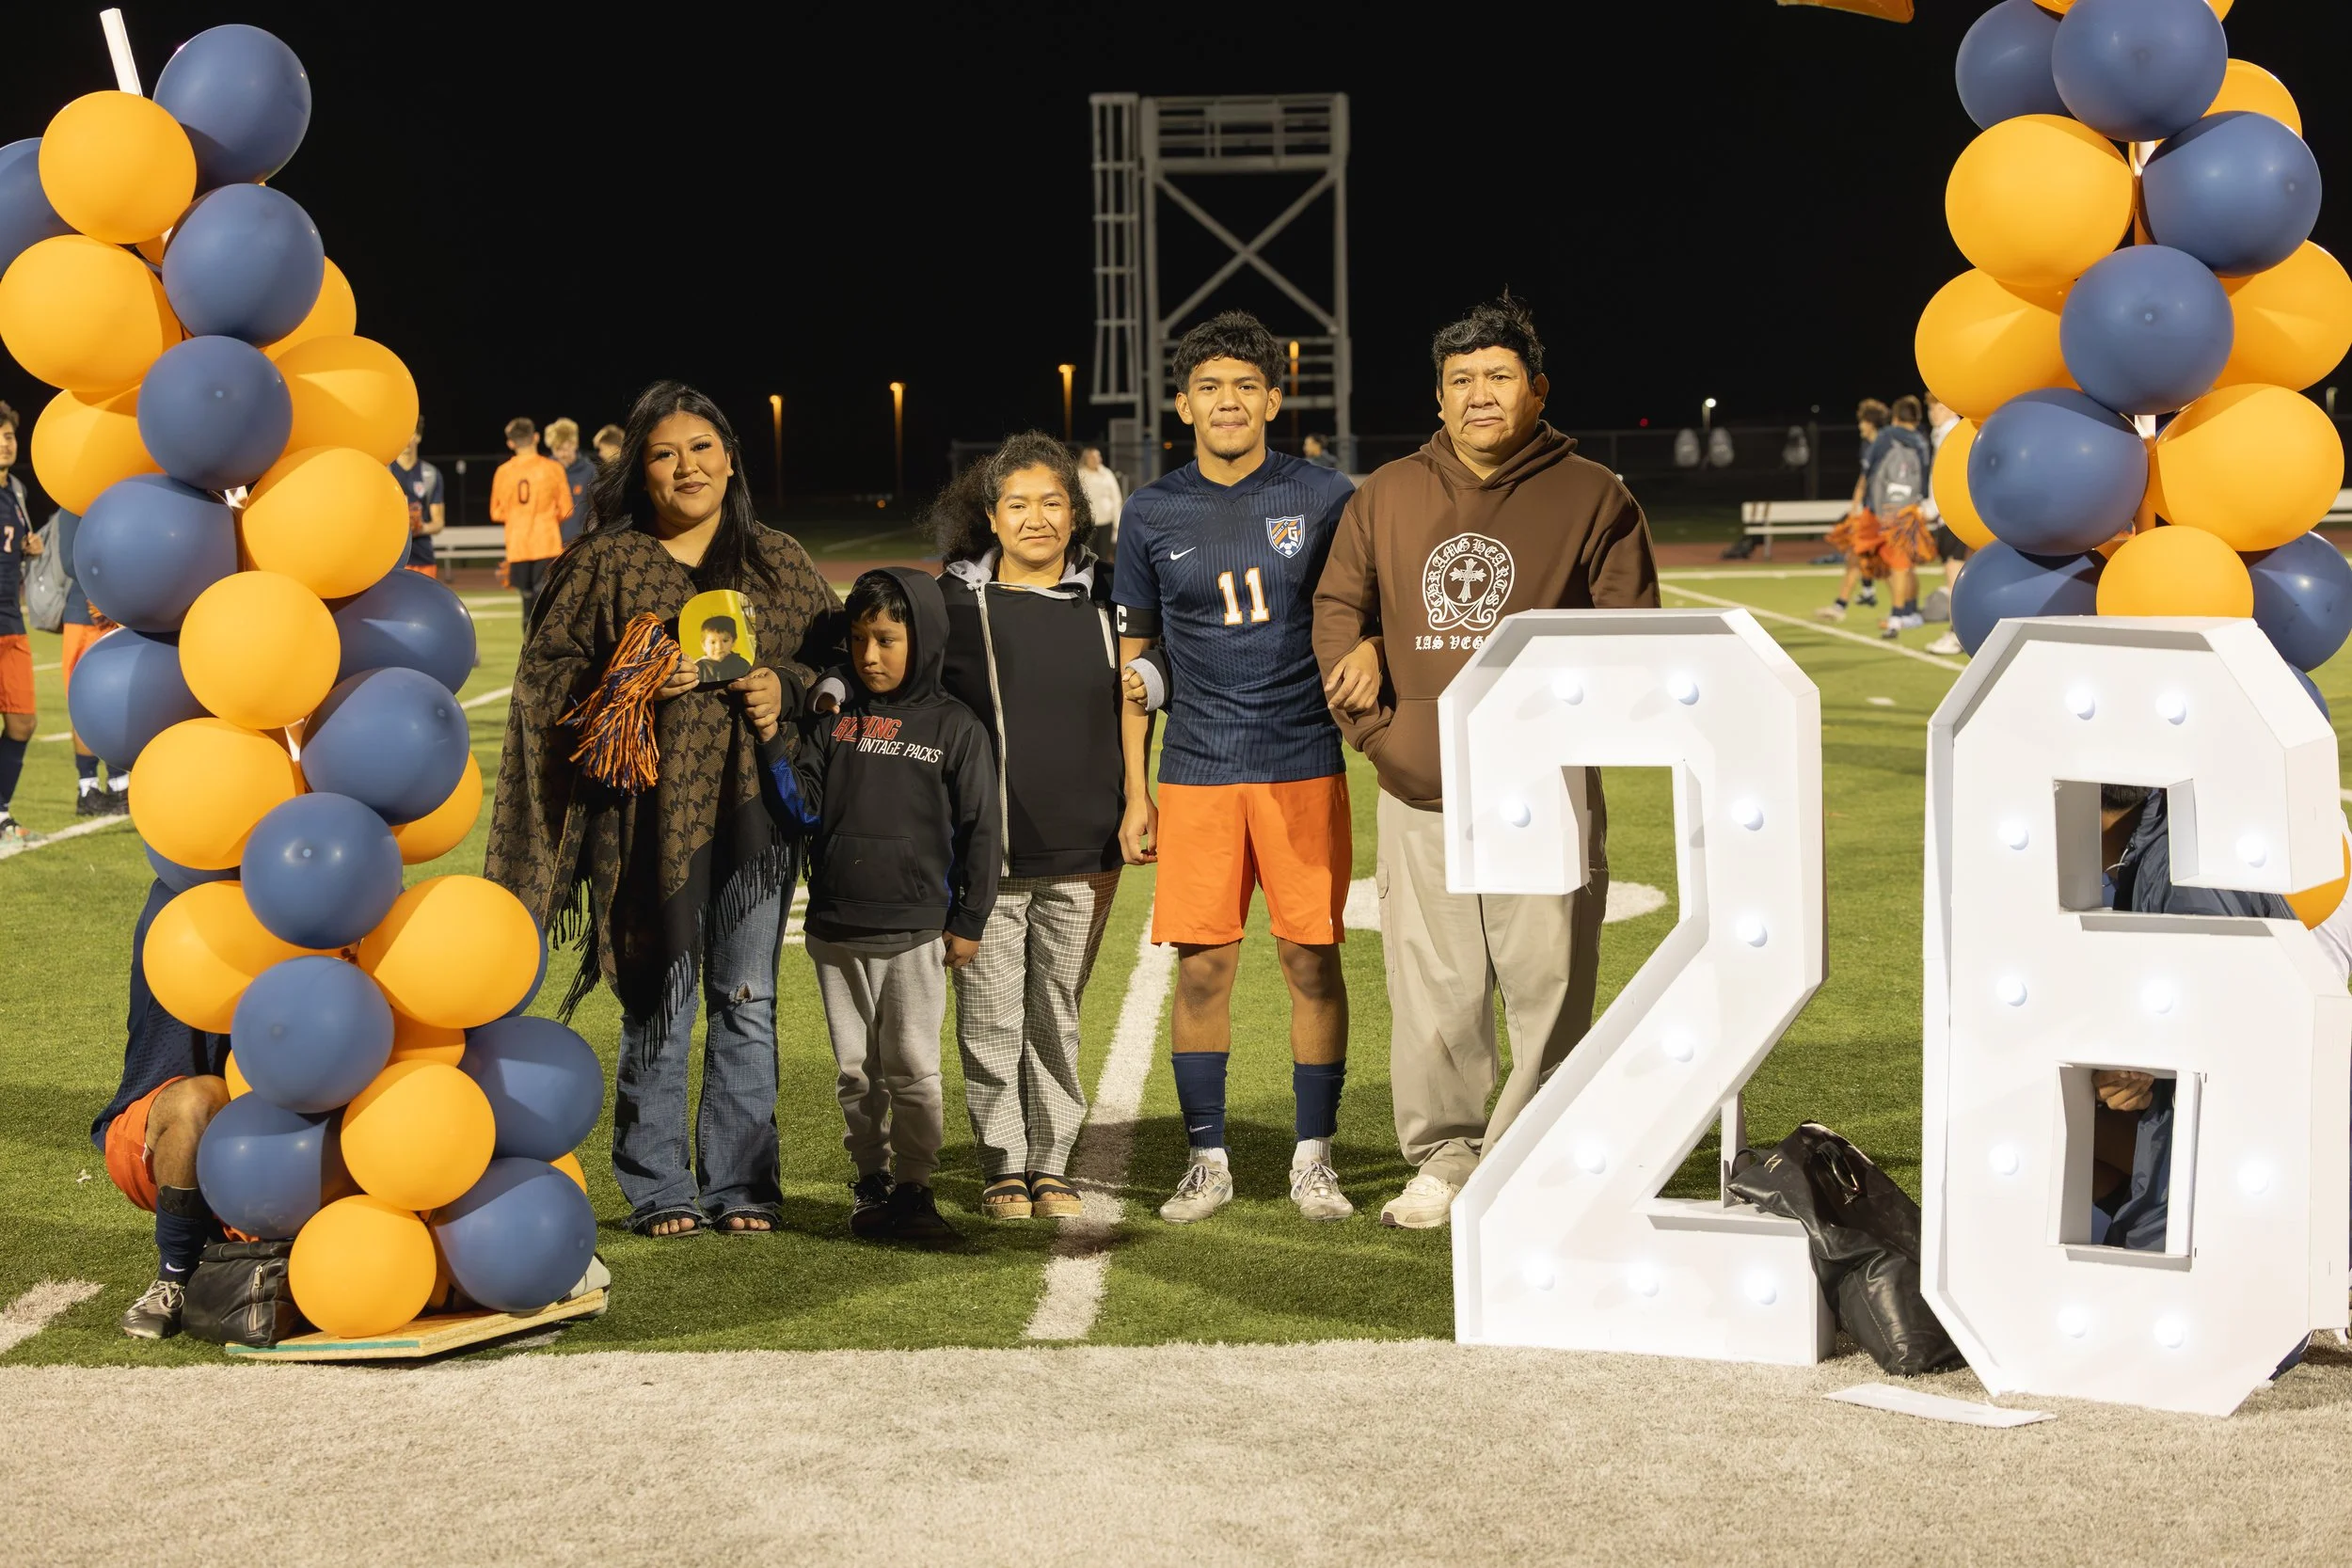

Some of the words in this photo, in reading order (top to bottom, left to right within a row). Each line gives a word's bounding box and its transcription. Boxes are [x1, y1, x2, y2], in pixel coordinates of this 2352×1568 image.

[518, 479, 530, 504] 0
[4, 526, 14, 553] 7
[1288, 527, 1298, 543] G
[1471, 538, 1510, 607] HEARTS
[1217, 567, 1270, 626] 11
[1117, 605, 1127, 632] C
[1415, 635, 1444, 650] LAS
[1450, 635, 1484, 650] VEG
[903, 743, 943, 763] PACKS
[1438, 609, 2350, 1416] 26
